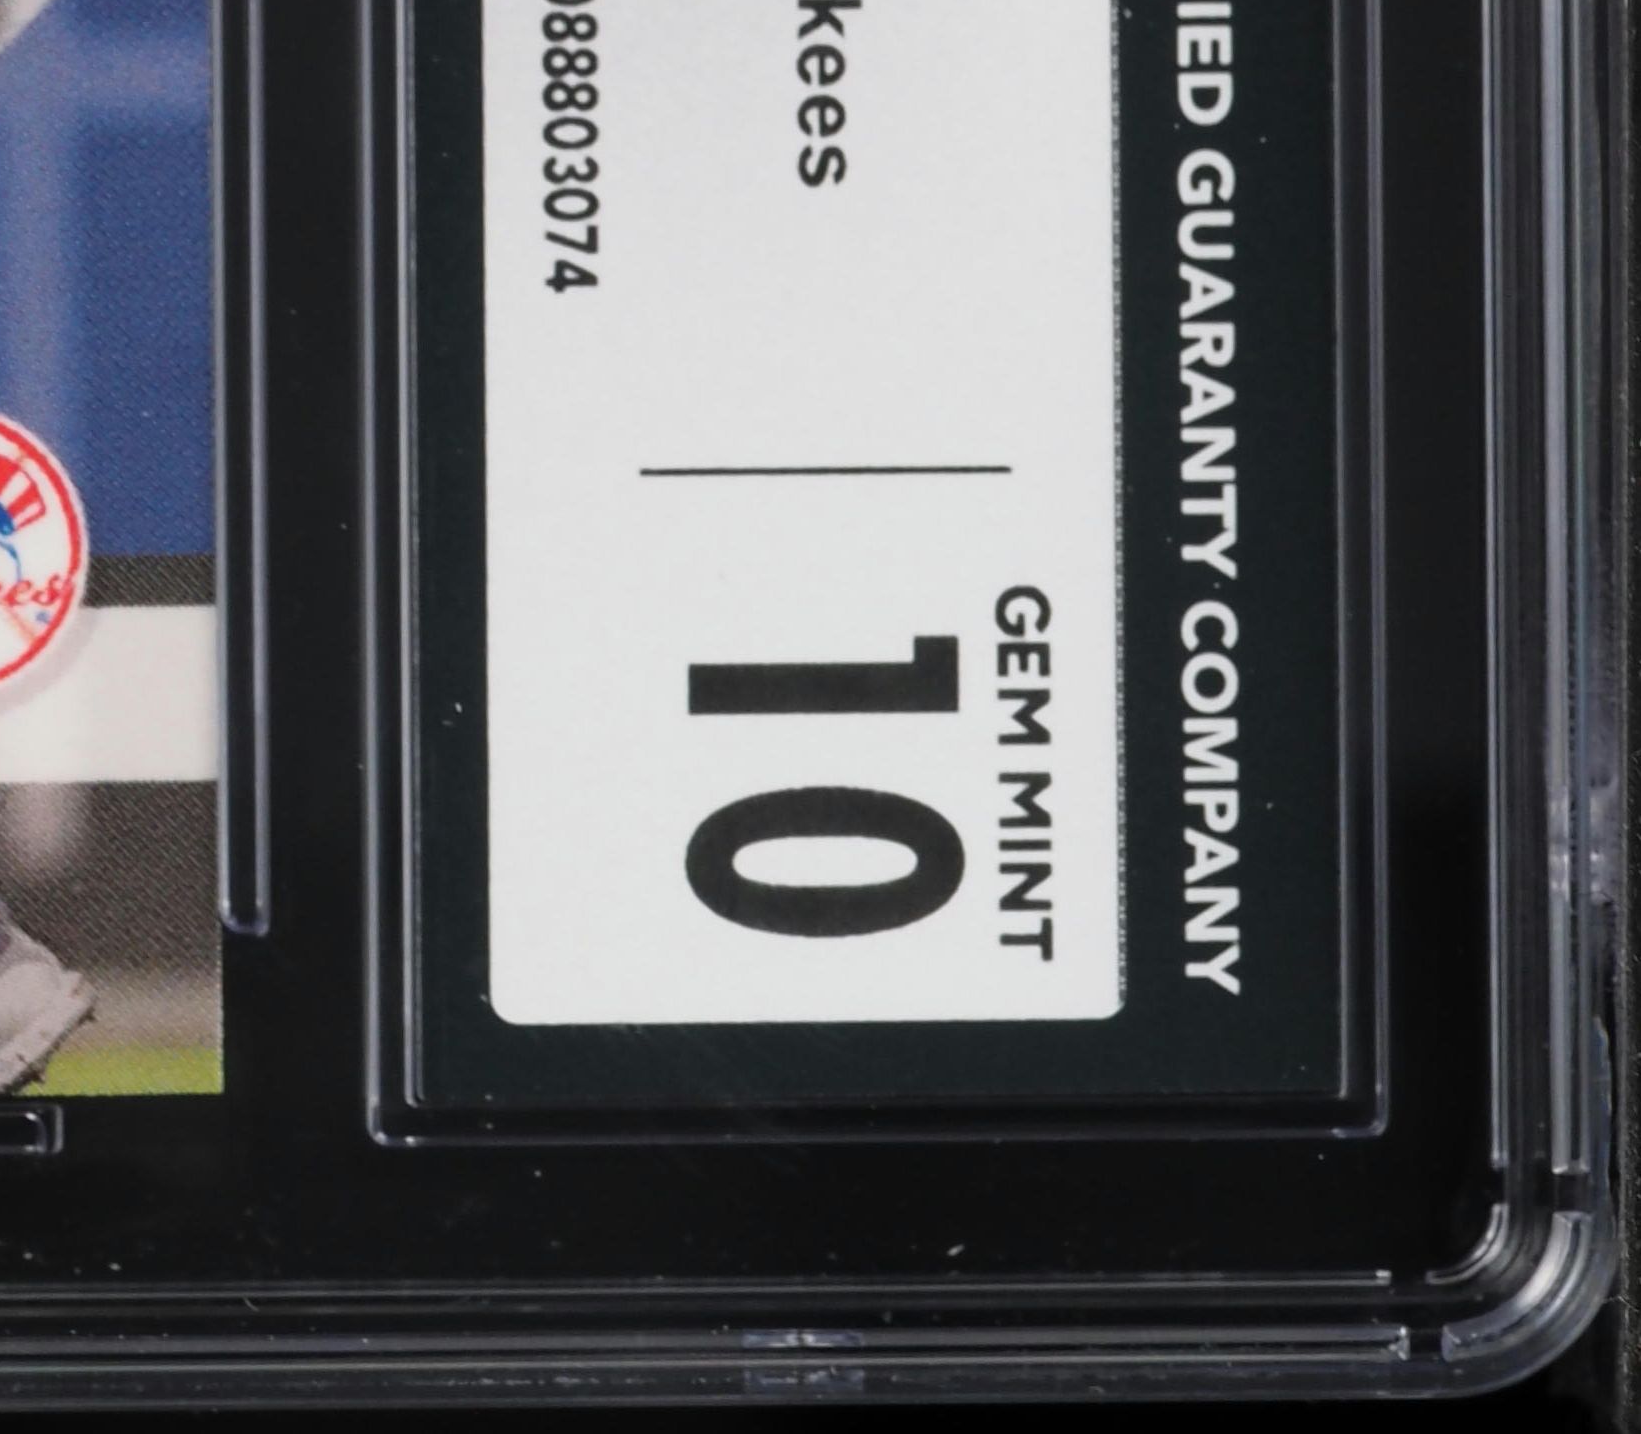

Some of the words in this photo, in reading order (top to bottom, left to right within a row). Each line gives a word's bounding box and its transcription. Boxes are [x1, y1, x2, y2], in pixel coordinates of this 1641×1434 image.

[1176, 148, 1237, 580] GUARANTY
[683, 634, 967, 939] 10
[994, 584, 1053, 747] GEM
[1179, 599, 1241, 996] COMPANY
[997, 771, 1055, 964] MINT
